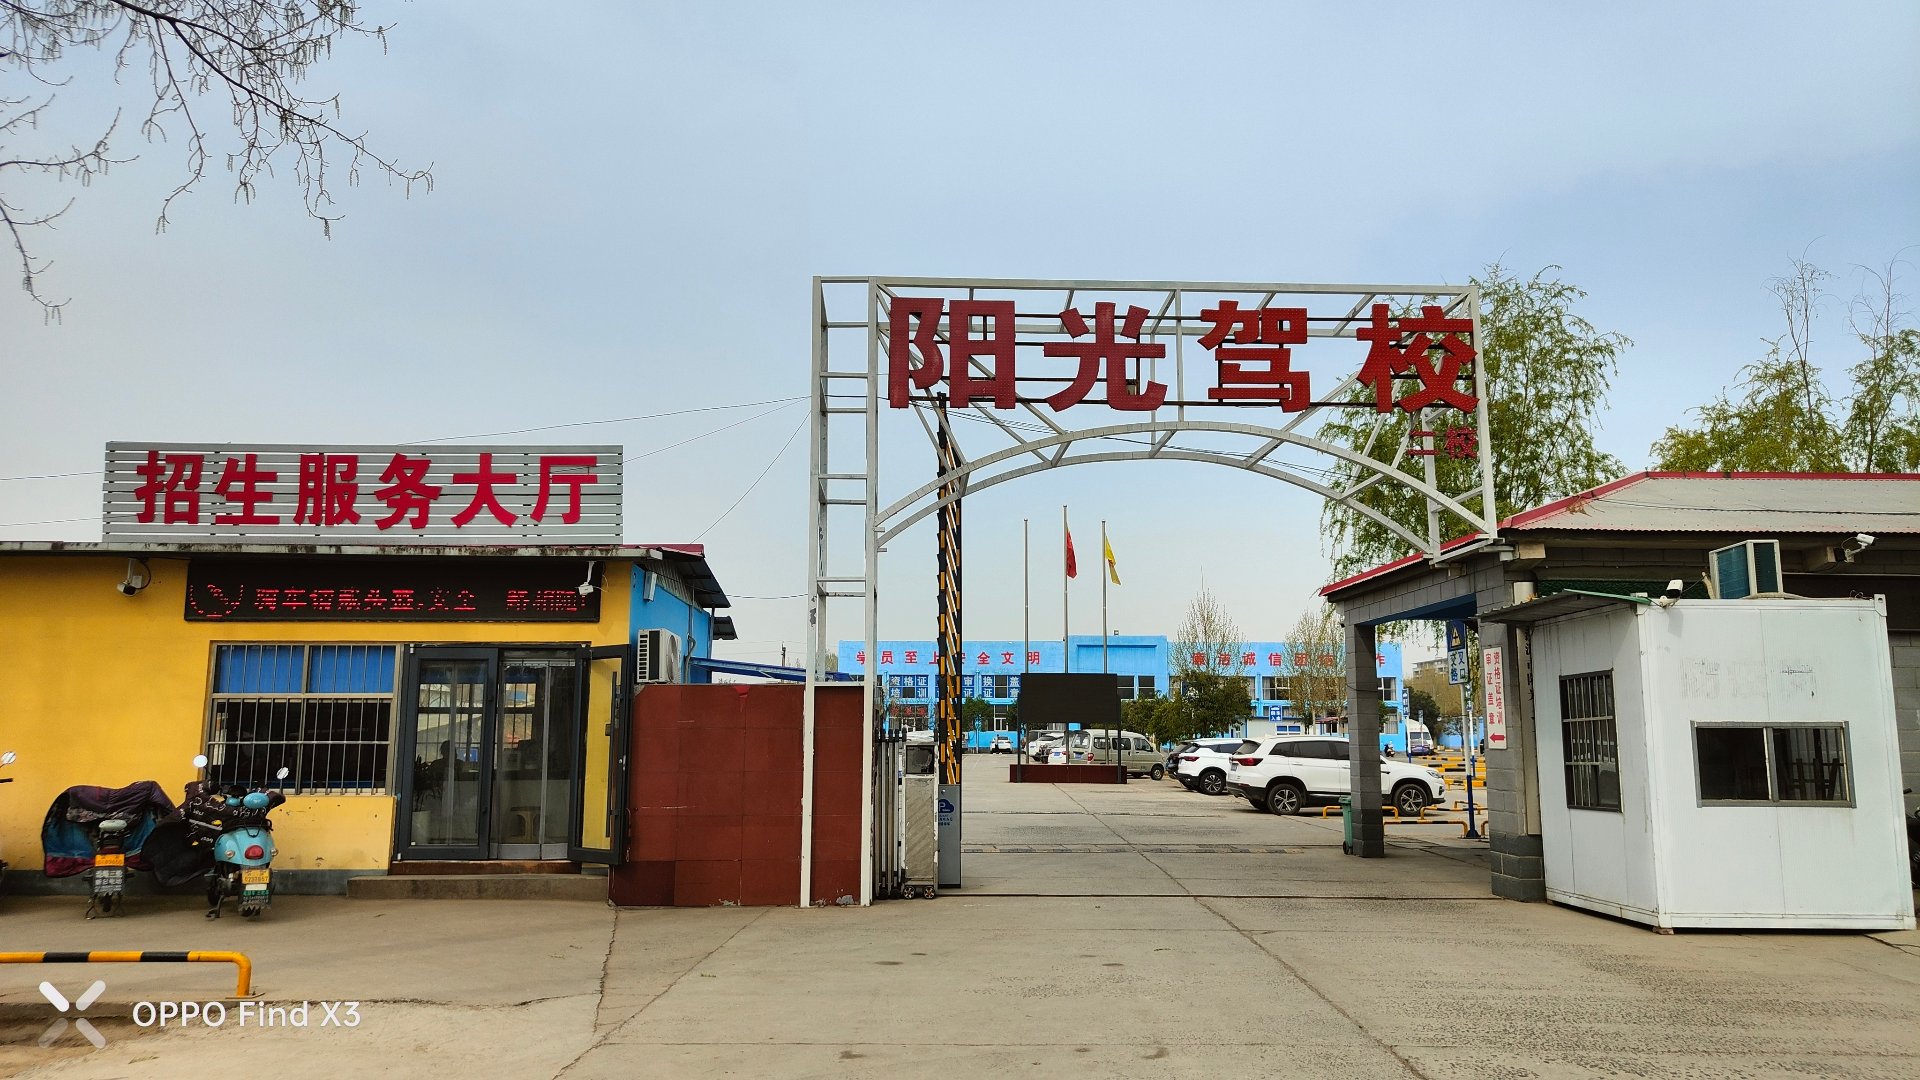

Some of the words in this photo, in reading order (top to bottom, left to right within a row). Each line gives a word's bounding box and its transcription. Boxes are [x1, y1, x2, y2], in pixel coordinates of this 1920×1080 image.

[888, 296, 1479, 413] 阳光驾校
[1406, 425, 1478, 460] 二校
[134, 451, 599, 530] 招生服务大厅
[856, 651, 1040, 665] 学员至上全文明
[890, 676, 928, 686] 资格证
[1486, 653, 1495, 725] 审证盖章
[1493, 652, 1503, 724] 资格证培训
